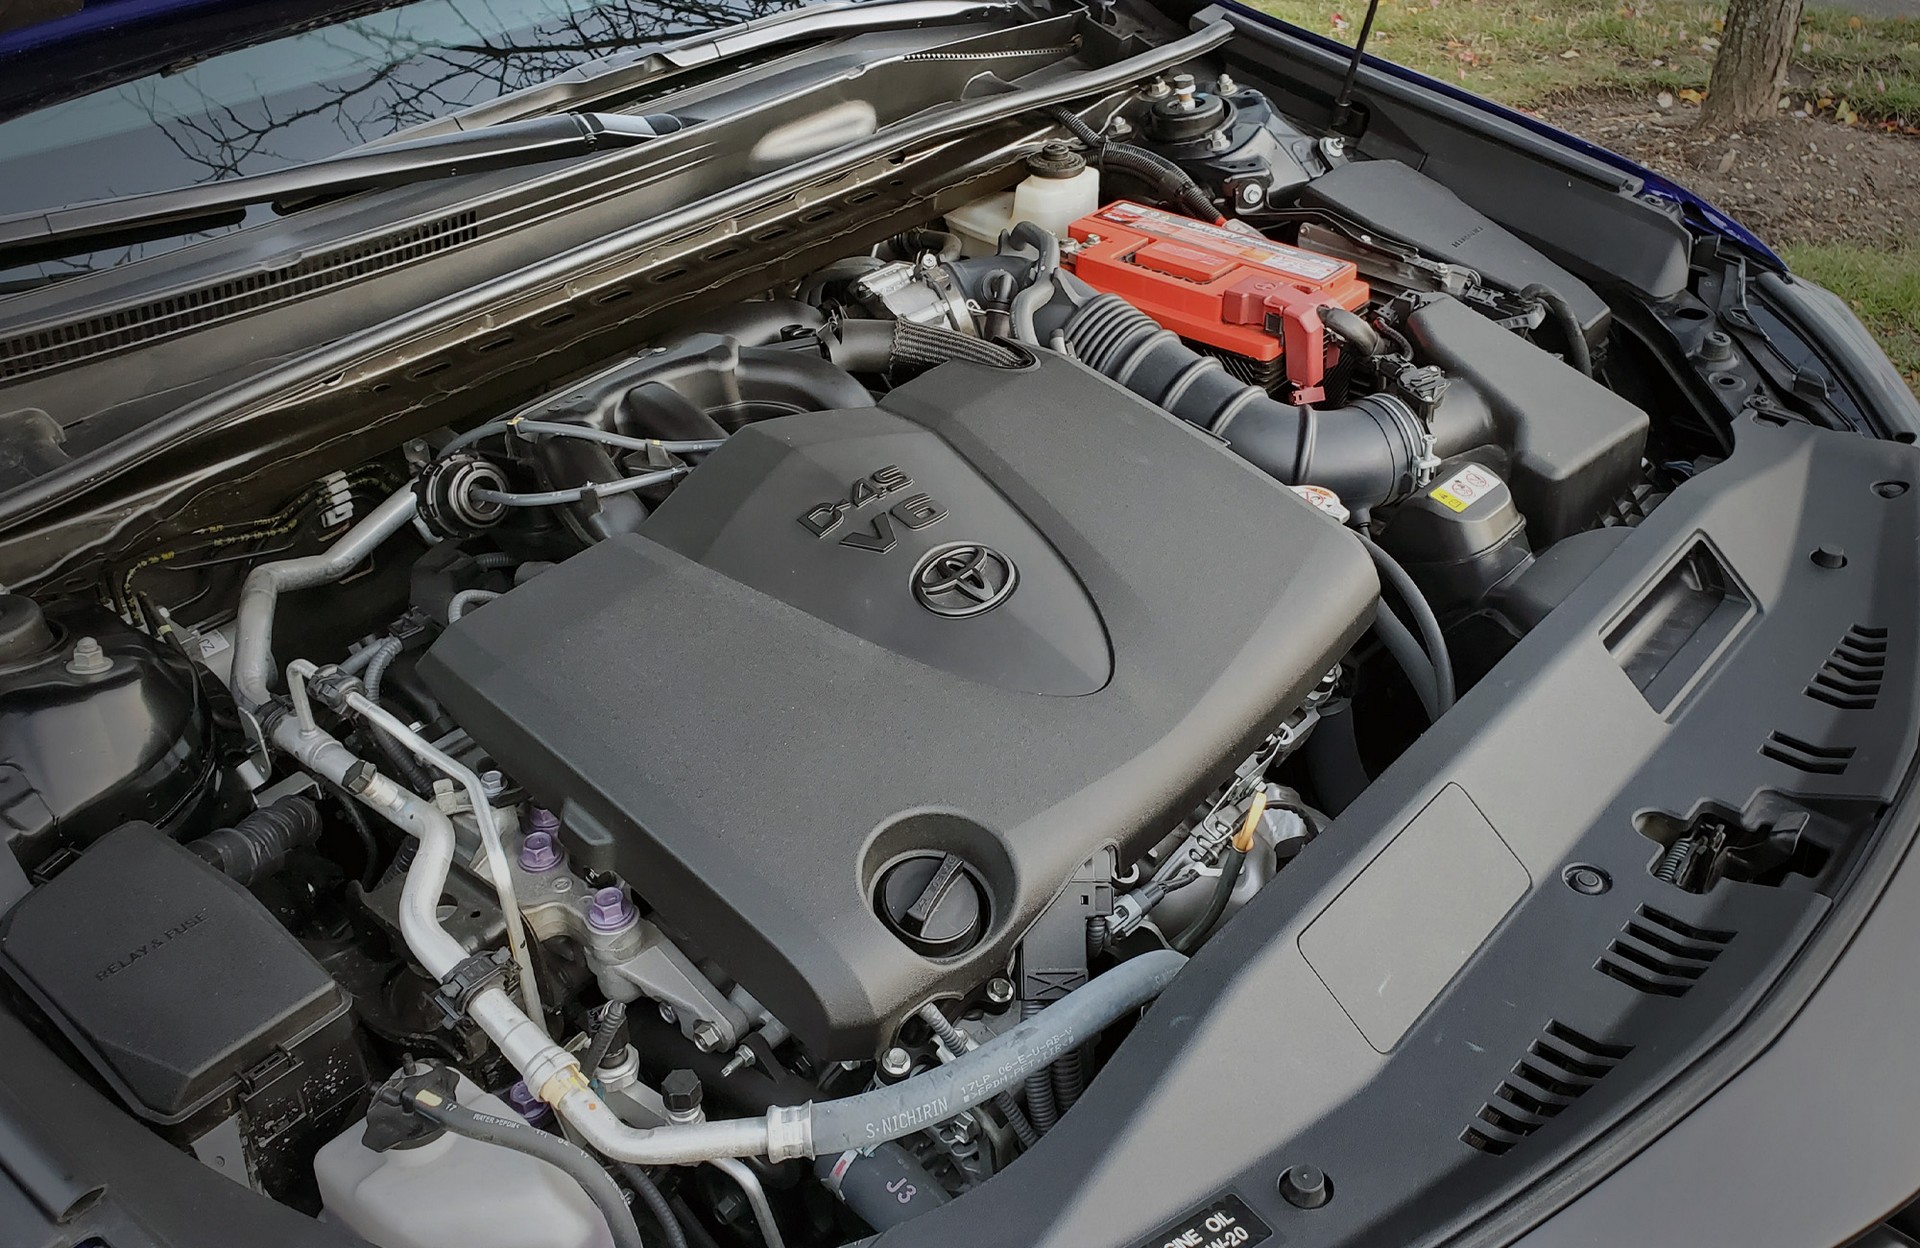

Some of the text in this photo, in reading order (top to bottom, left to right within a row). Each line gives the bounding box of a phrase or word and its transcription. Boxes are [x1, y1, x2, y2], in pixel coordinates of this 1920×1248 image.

[796, 464, 915, 540] D-4S
[838, 492, 950, 555] V6
[96, 912, 208, 981] RELAY & FUSE
[961, 1074, 991, 1095] 17LP
[472, 1112, 494, 1124] WATER
[886, 1177, 917, 1204] J3
[1205, 1212, 1236, 1232] OIL
